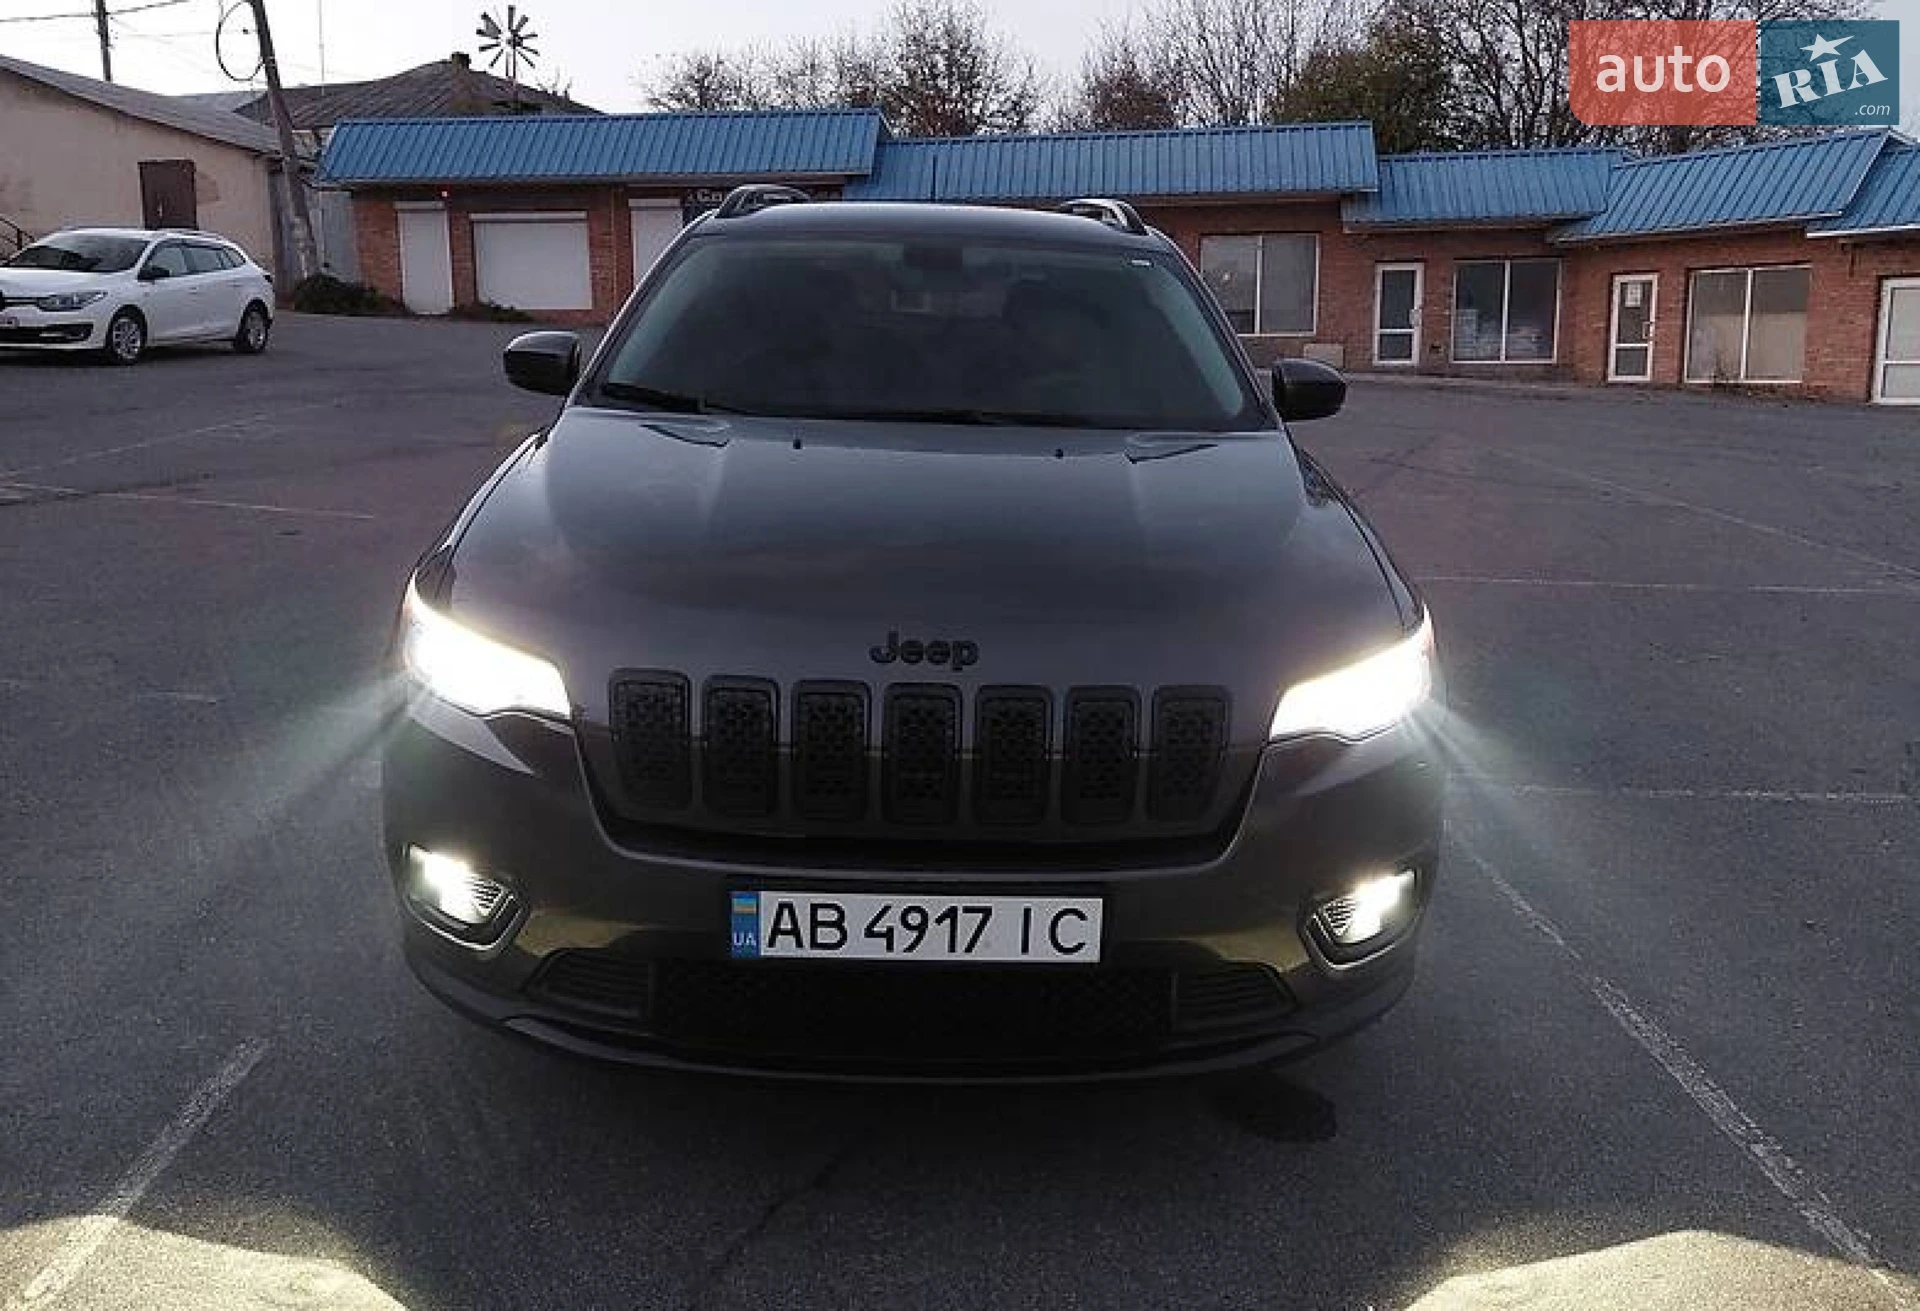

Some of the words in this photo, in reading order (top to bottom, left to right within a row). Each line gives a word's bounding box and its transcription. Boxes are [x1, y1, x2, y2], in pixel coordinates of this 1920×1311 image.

[868, 630, 980, 671] Jeep
[733, 932, 757, 947] UA
[767, 901, 848, 950] AB
[863, 905, 993, 953] 4917
[1020, 907, 1088, 955] IC
